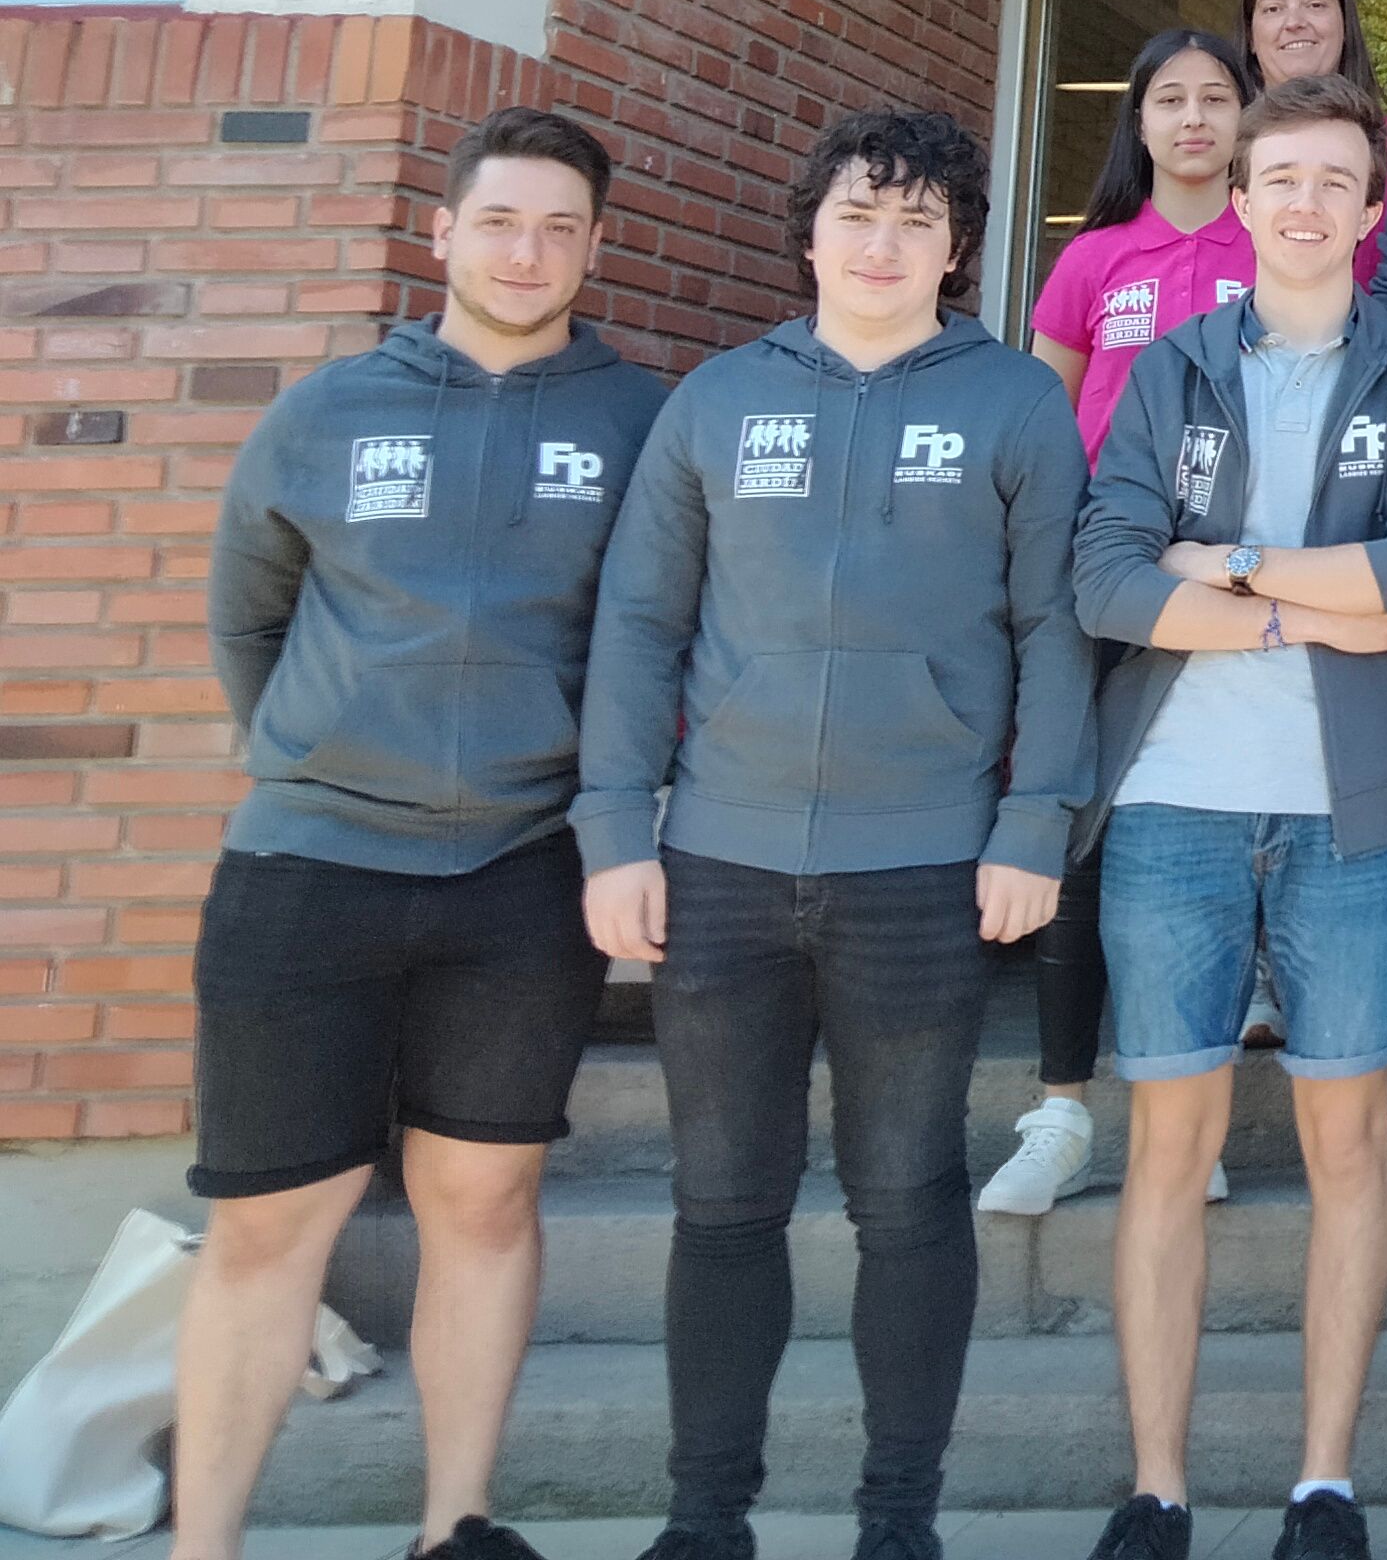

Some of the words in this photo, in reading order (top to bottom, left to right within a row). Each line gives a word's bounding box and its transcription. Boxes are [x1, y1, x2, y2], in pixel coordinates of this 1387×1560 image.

[1105, 318, 1151, 330] CIUDAD
[540, 442, 603, 485] Fp
[901, 424, 964, 467] Fp
